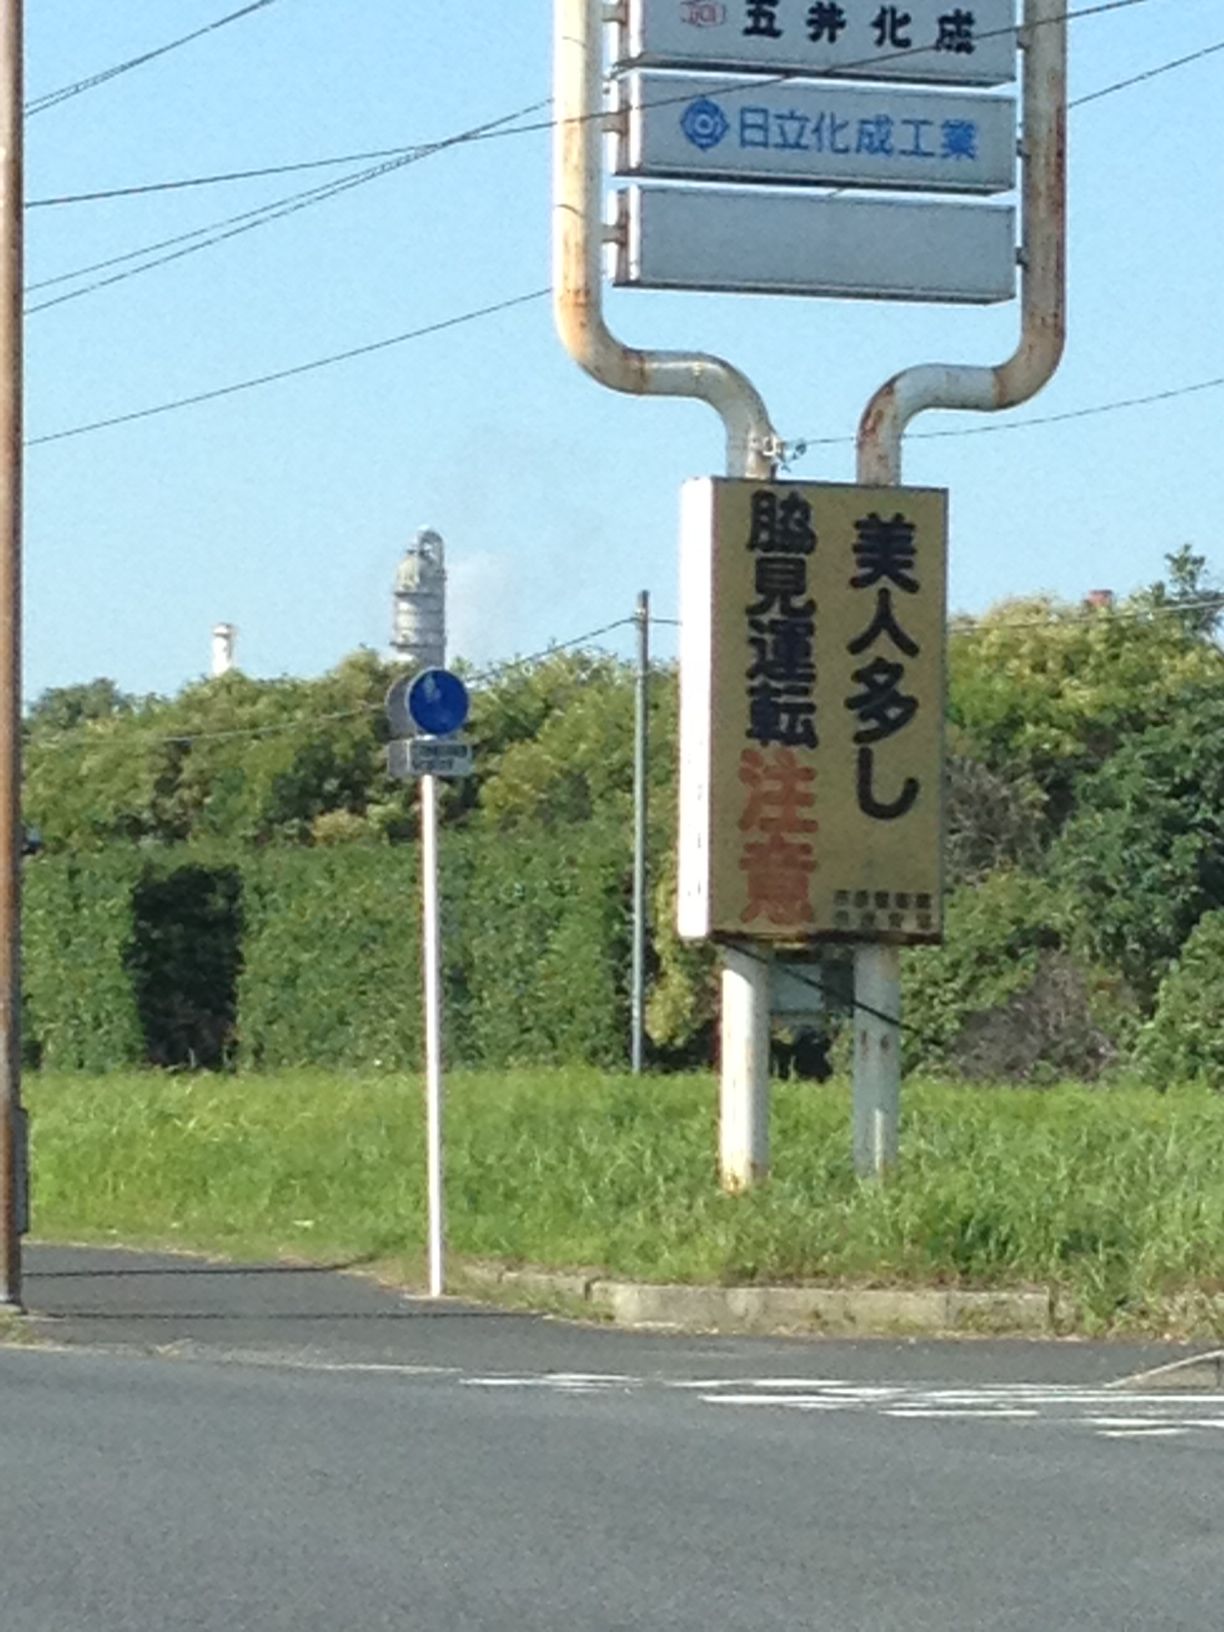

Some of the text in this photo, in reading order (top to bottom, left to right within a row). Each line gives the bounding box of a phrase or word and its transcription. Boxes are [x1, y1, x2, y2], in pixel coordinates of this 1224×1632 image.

[742, 0, 976, 54] 五井化成
[739, 106, 979, 160] 日立化成工業
[738, 489, 818, 926] 脇見運転注意
[844, 512, 920, 820] 美人多し
